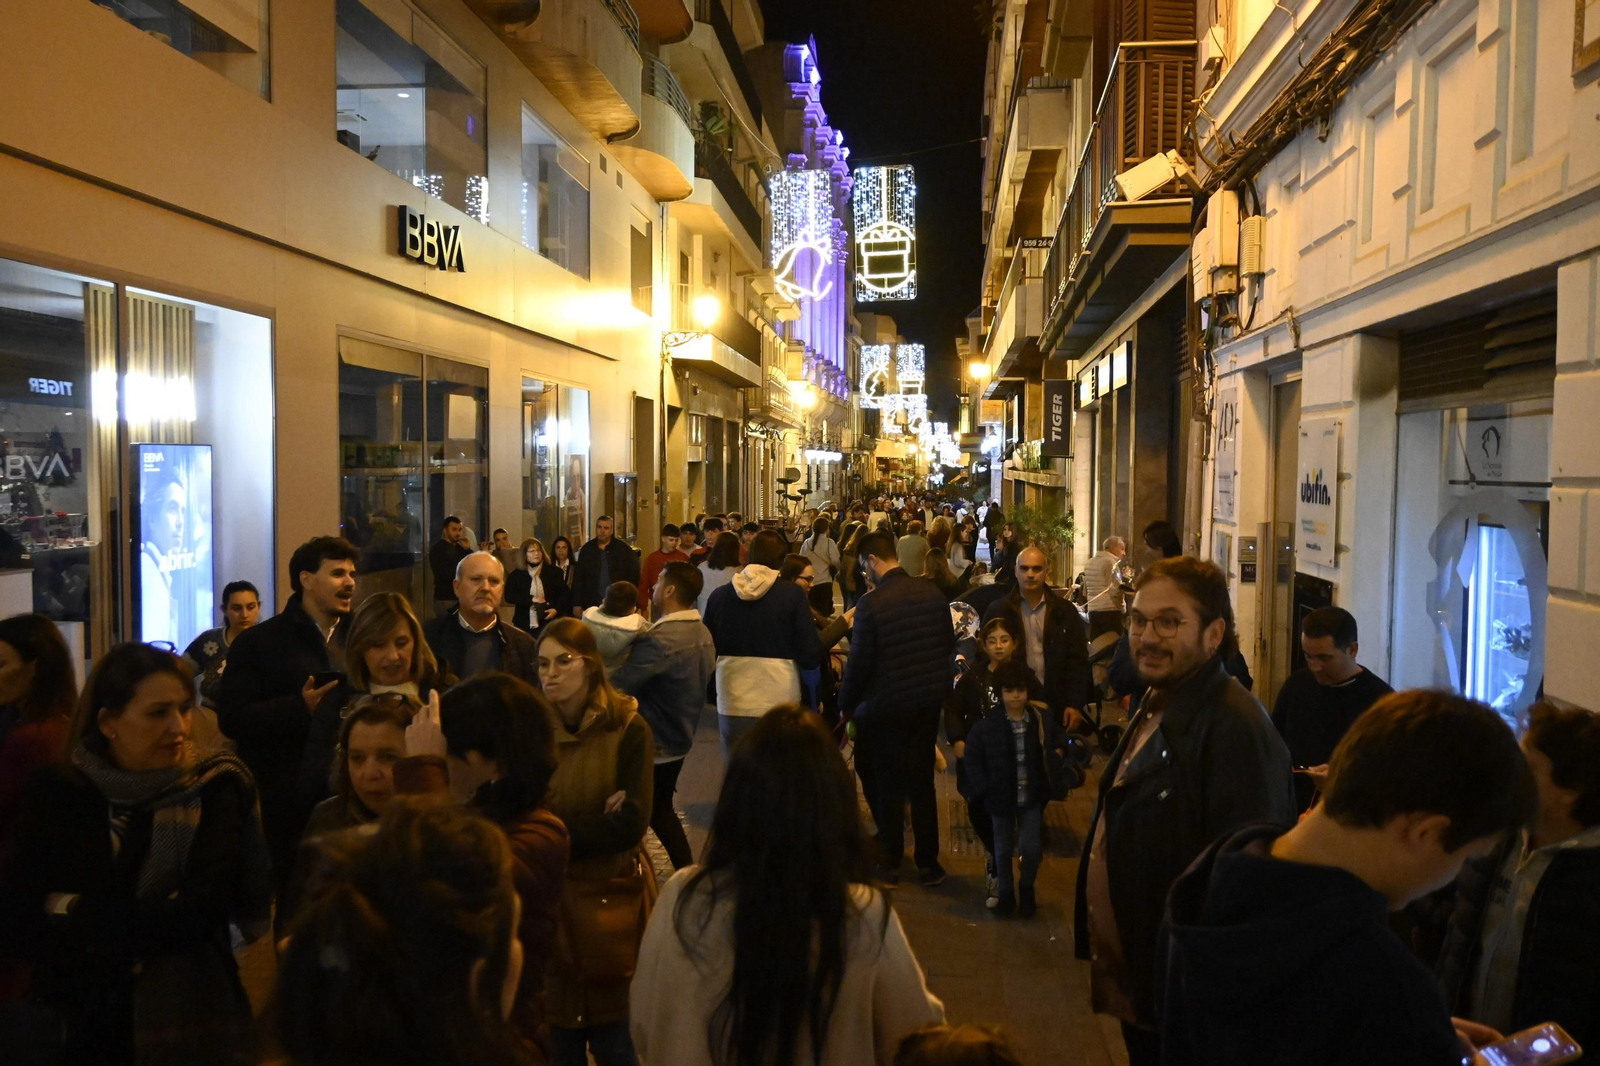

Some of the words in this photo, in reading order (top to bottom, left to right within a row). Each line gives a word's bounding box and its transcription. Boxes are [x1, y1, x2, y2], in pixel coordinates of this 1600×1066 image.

[399, 204, 466, 273] BBVA
[1051, 393, 1064, 442] TIGER
[0, 452, 70, 480] BVA
